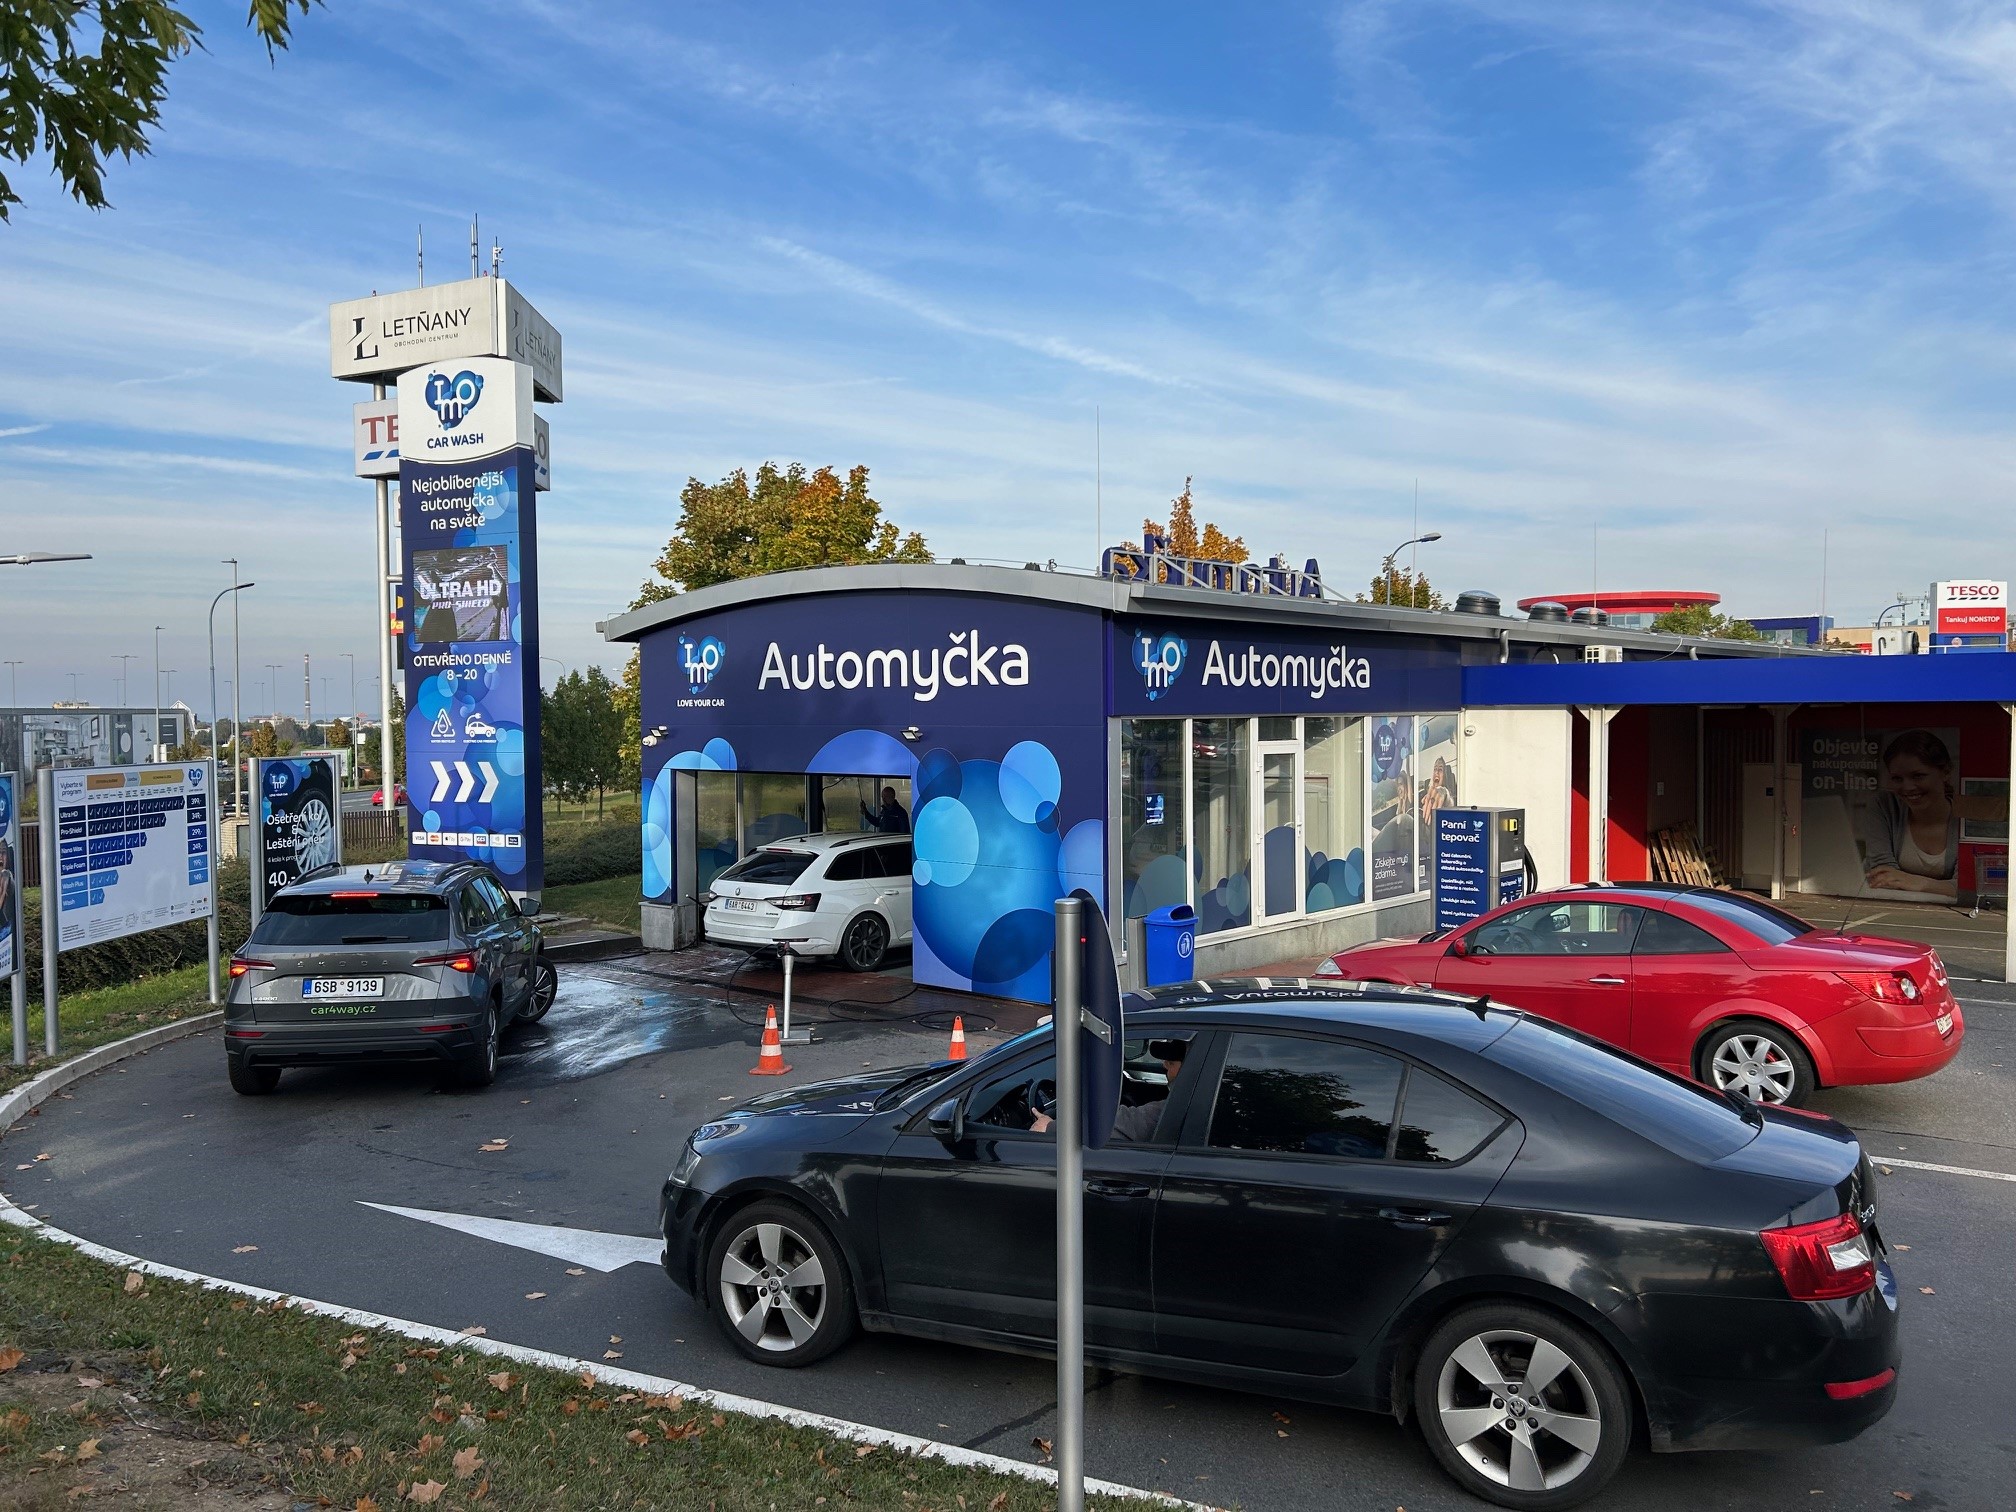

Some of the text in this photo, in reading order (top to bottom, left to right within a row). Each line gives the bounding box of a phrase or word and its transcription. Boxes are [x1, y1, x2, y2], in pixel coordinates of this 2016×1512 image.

[382, 307, 471, 338] LETŇANY
[394, 333, 459, 348] OBCHODNÍ CENTRUM
[427, 432, 484, 449] CAR WASH
[411, 470, 504, 495] Nejoblíbenější
[420, 490, 495, 512] automyčka
[430, 512, 486, 531] na světě
[476, 579, 503, 597] HD
[1947, 585, 2000, 596] TESCO
[1945, 615, 2000, 625] Tankuj NONSTOP
[413, 650, 512, 667] OTEVŘENO DENNĚ
[757, 628, 1030, 702] Automyčka
[1201, 639, 1372, 700] Automyčka
[677, 698, 725, 707] LOVE YOUR CAR
[1812, 738, 1879, 758] Objevte
[1812, 757, 1878, 770] nakupování
[60, 782, 78, 790] Vyberte
[1812, 771, 1879, 790] on-line
[61, 789, 83, 797] program
[1441, 819, 1467, 829] Parní
[266, 836, 301, 850] Leštění
[1441, 832, 1480, 843] tepovač
[314, 981, 337, 994] 6SB
[346, 980, 378, 993] 9139
[310, 1005, 377, 1015] car4way.cz
